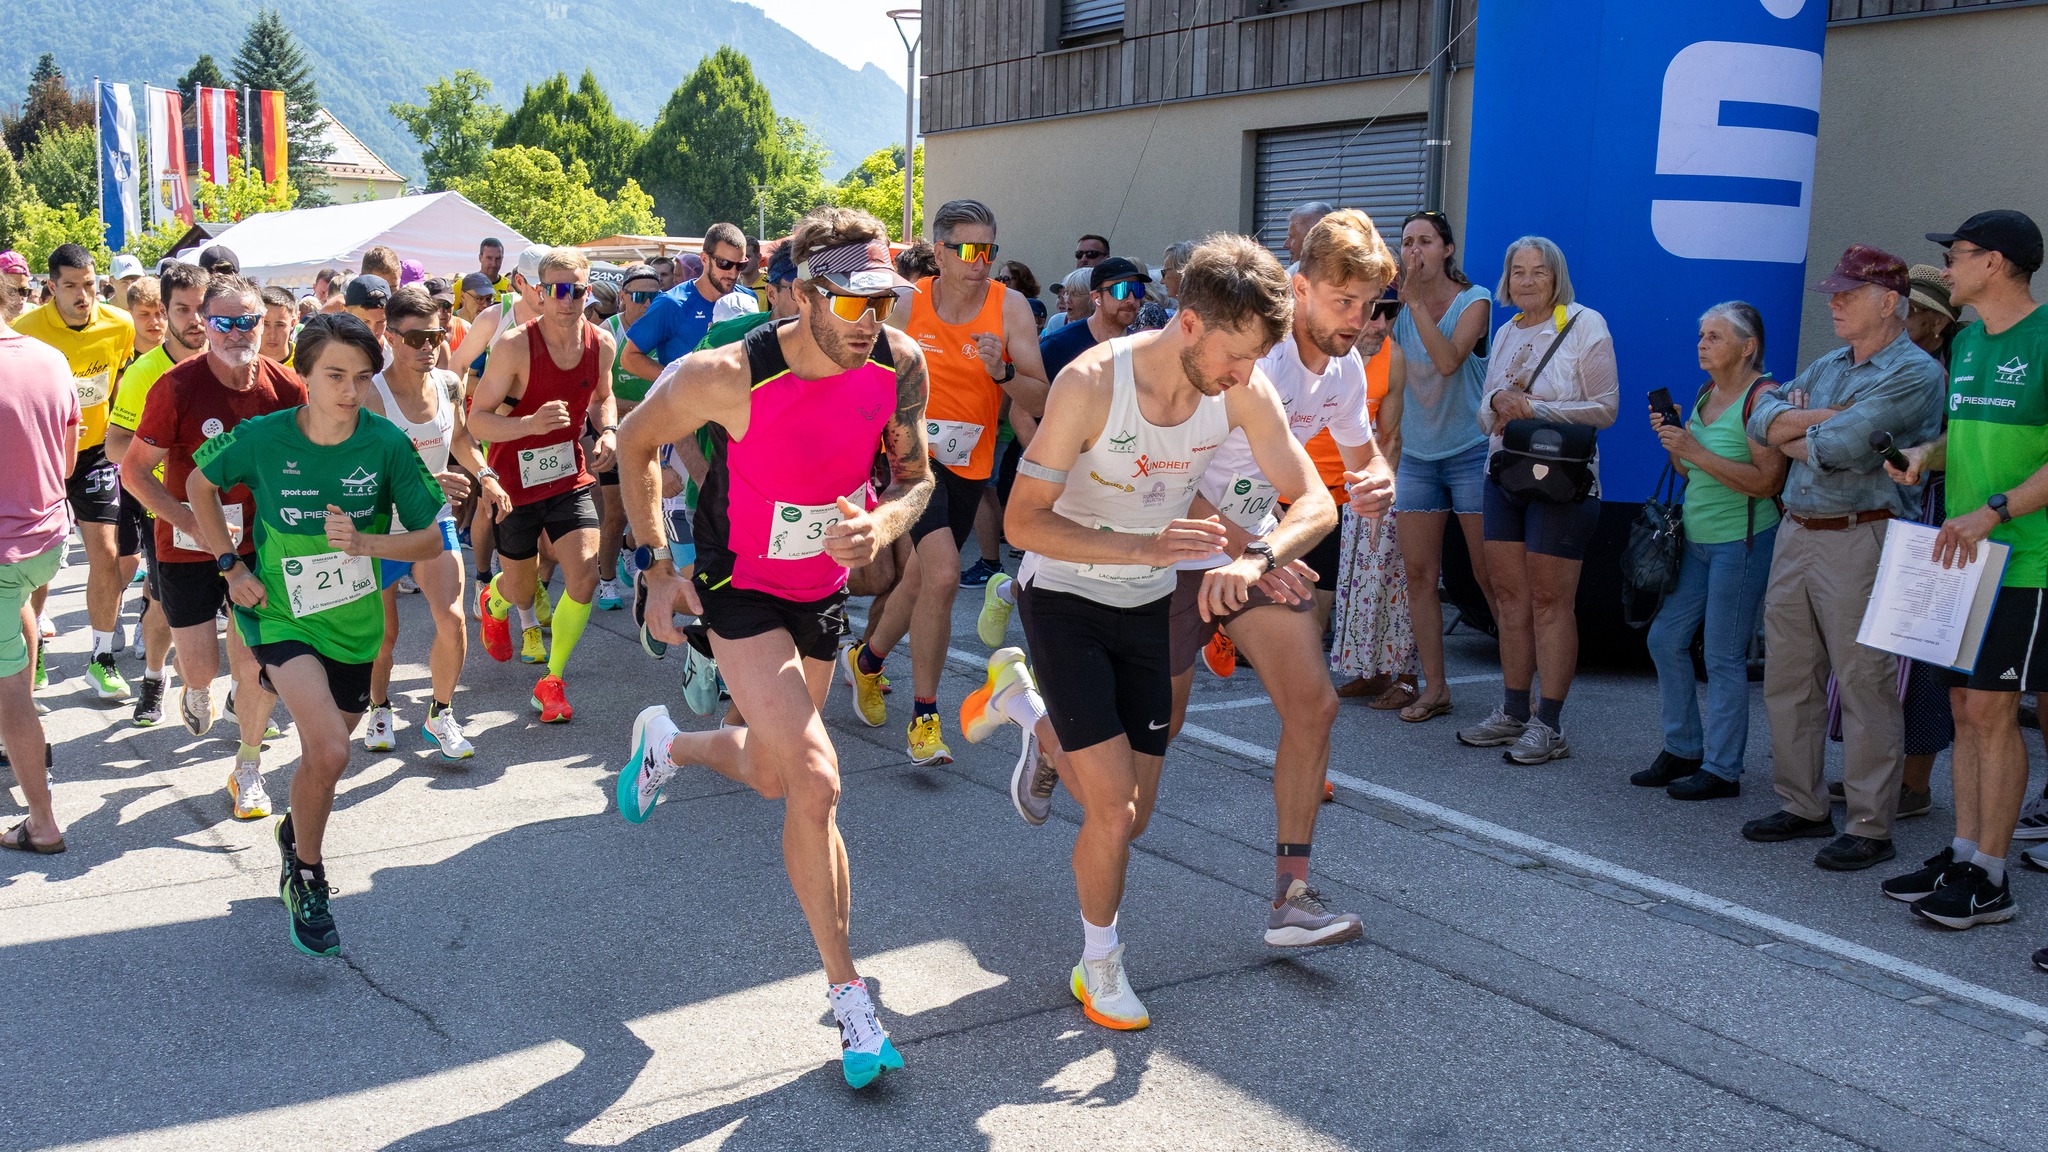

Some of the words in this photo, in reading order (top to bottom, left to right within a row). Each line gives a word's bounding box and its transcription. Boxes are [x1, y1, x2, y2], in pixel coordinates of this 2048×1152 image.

[946, 438, 957, 453] 9
[539, 455, 559, 471] 88
[281, 489, 301, 497] sport
[1240, 495, 1274, 514] 104
[315, 567, 344, 590] 21
